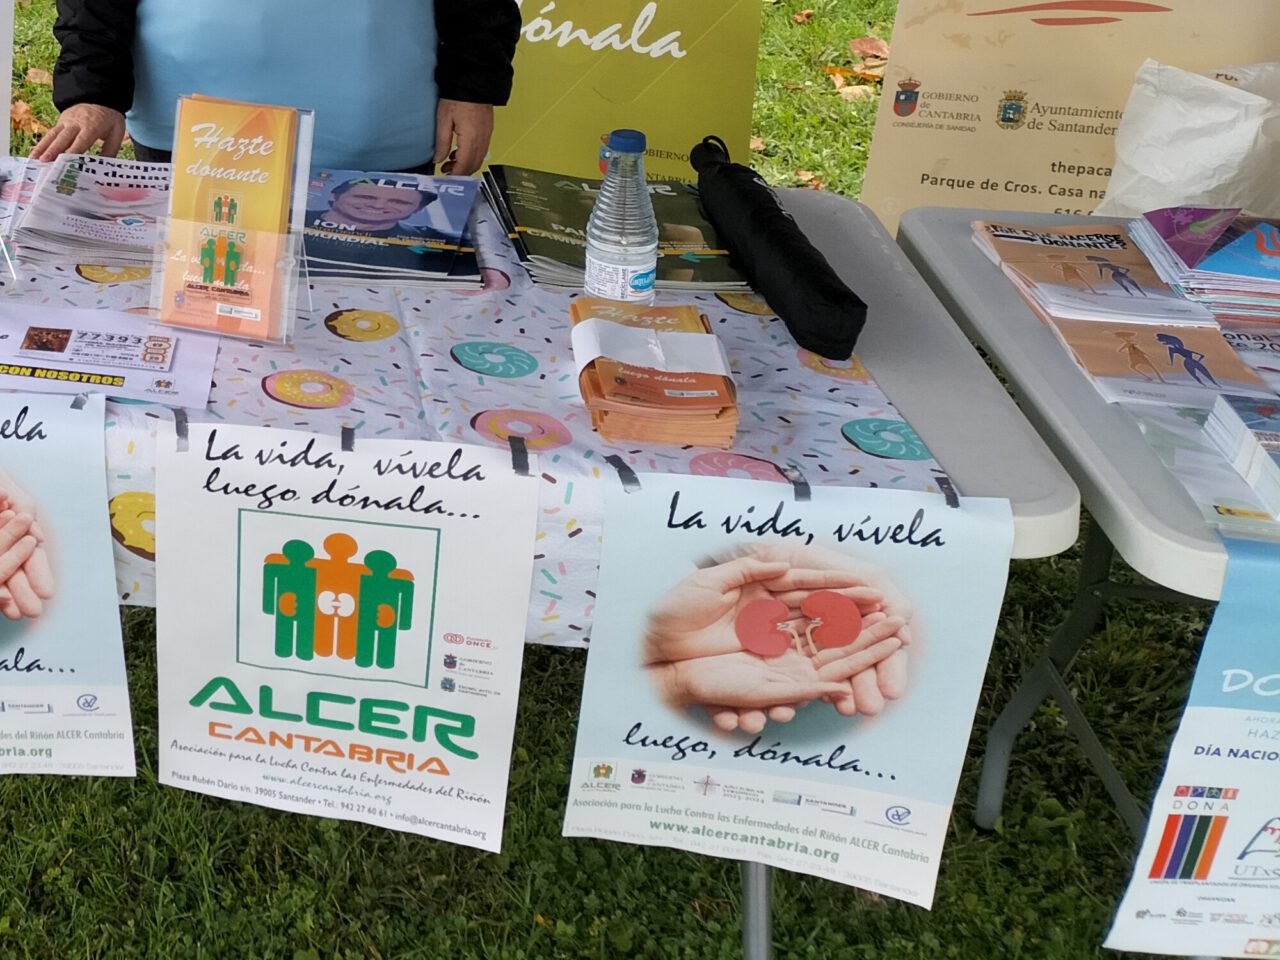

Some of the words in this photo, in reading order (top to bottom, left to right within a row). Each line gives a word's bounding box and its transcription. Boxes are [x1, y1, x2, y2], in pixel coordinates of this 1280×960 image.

[920, 101, 930, 109] de
[922, 91, 979, 103] GOBIERNO
[918, 110, 982, 122] CANTABRIA
[1027, 118, 1044, 130] de
[1048, 119, 1117, 136] Santander
[190, 122, 274, 159] Hazte
[186, 160, 270, 185] donante
[1051, 161, 1112, 177] thepaca
[349, 178, 465, 196] ALCER
[921, 173, 974, 189] Parque
[980, 178, 998, 190] de
[1004, 181, 1042, 194] Cros.
[1048, 184, 1083, 198] Casa
[591, 306, 680, 325] Hazte
[34, 368, 124, 386] NOSOTROS
[205, 429, 243, 461] La
[255, 438, 345, 475] vida,
[373, 448, 485, 482] vívela
[203, 467, 297, 510] luego
[311, 479, 480, 519] dónala...
[667, 491, 707, 531] La
[721, 501, 815, 545] vida,
[833, 508, 946, 548] vívela
[189, 676, 479, 760] ALCER
[208, 721, 450, 776] CANTABRIA
[623, 722, 717, 762] luego,
[733, 737, 897, 781] dónala...
[1194, 744, 1221, 756] DÍA
[171, 739, 226, 757] Asociación
[228, 752, 252, 761] para
[255, 754, 266, 764] la
[270, 756, 298, 769] Lucha
[301, 762, 337, 776] Contra
[340, 768, 357, 781] las
[360, 772, 432, 794] Enfermedades
[435, 786, 453, 798] del
[457, 788, 491, 805] Riñón
[172, 771, 190, 782] Plaza
[192, 774, 215, 787] Rubén
[255, 787, 276, 798] 39005
[278, 792, 315, 805] Santander
[340, 801, 354, 811] 942
[357, 804, 365, 813] 27
[368, 806, 377, 816] 60
[1172, 800, 1230, 811] DONA
[649, 819, 840, 863] www.alcercantabria.org
